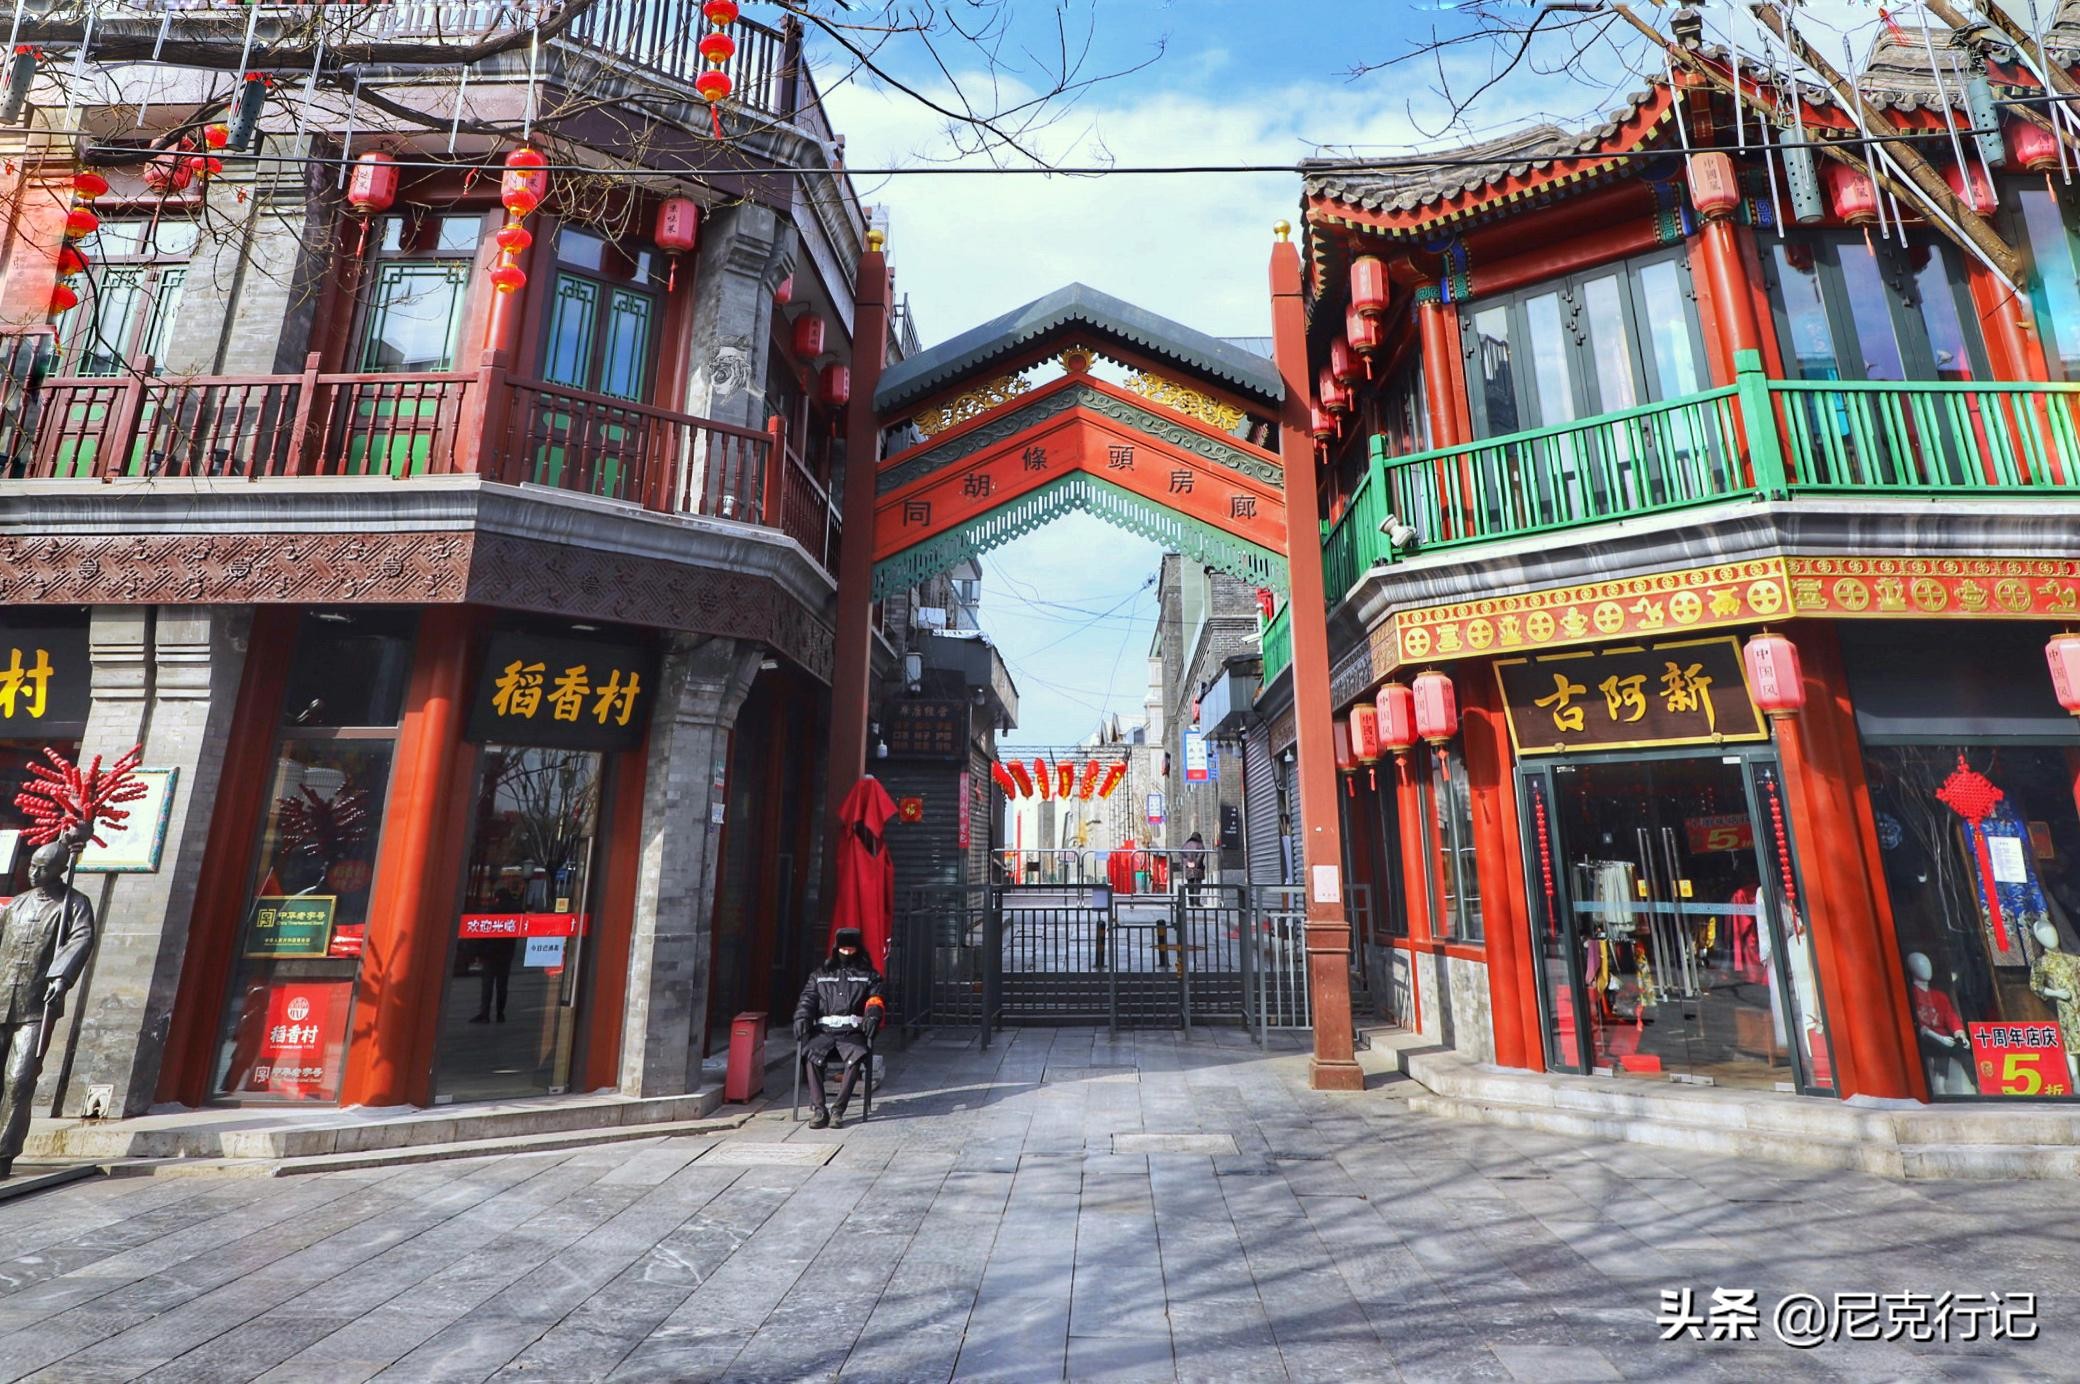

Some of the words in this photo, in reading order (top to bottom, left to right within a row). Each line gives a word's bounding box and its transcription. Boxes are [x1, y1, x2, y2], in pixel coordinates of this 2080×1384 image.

[0, 648, 54, 718] 村
[492, 660, 640, 726] 稻香村
[278, 911, 326, 921] 中华老字号
[467, 919, 517, 933] 欢迎光临
[270, 1024, 319, 1044] 稻香村
[1976, 1027, 2058, 1048] 十周年店庆
